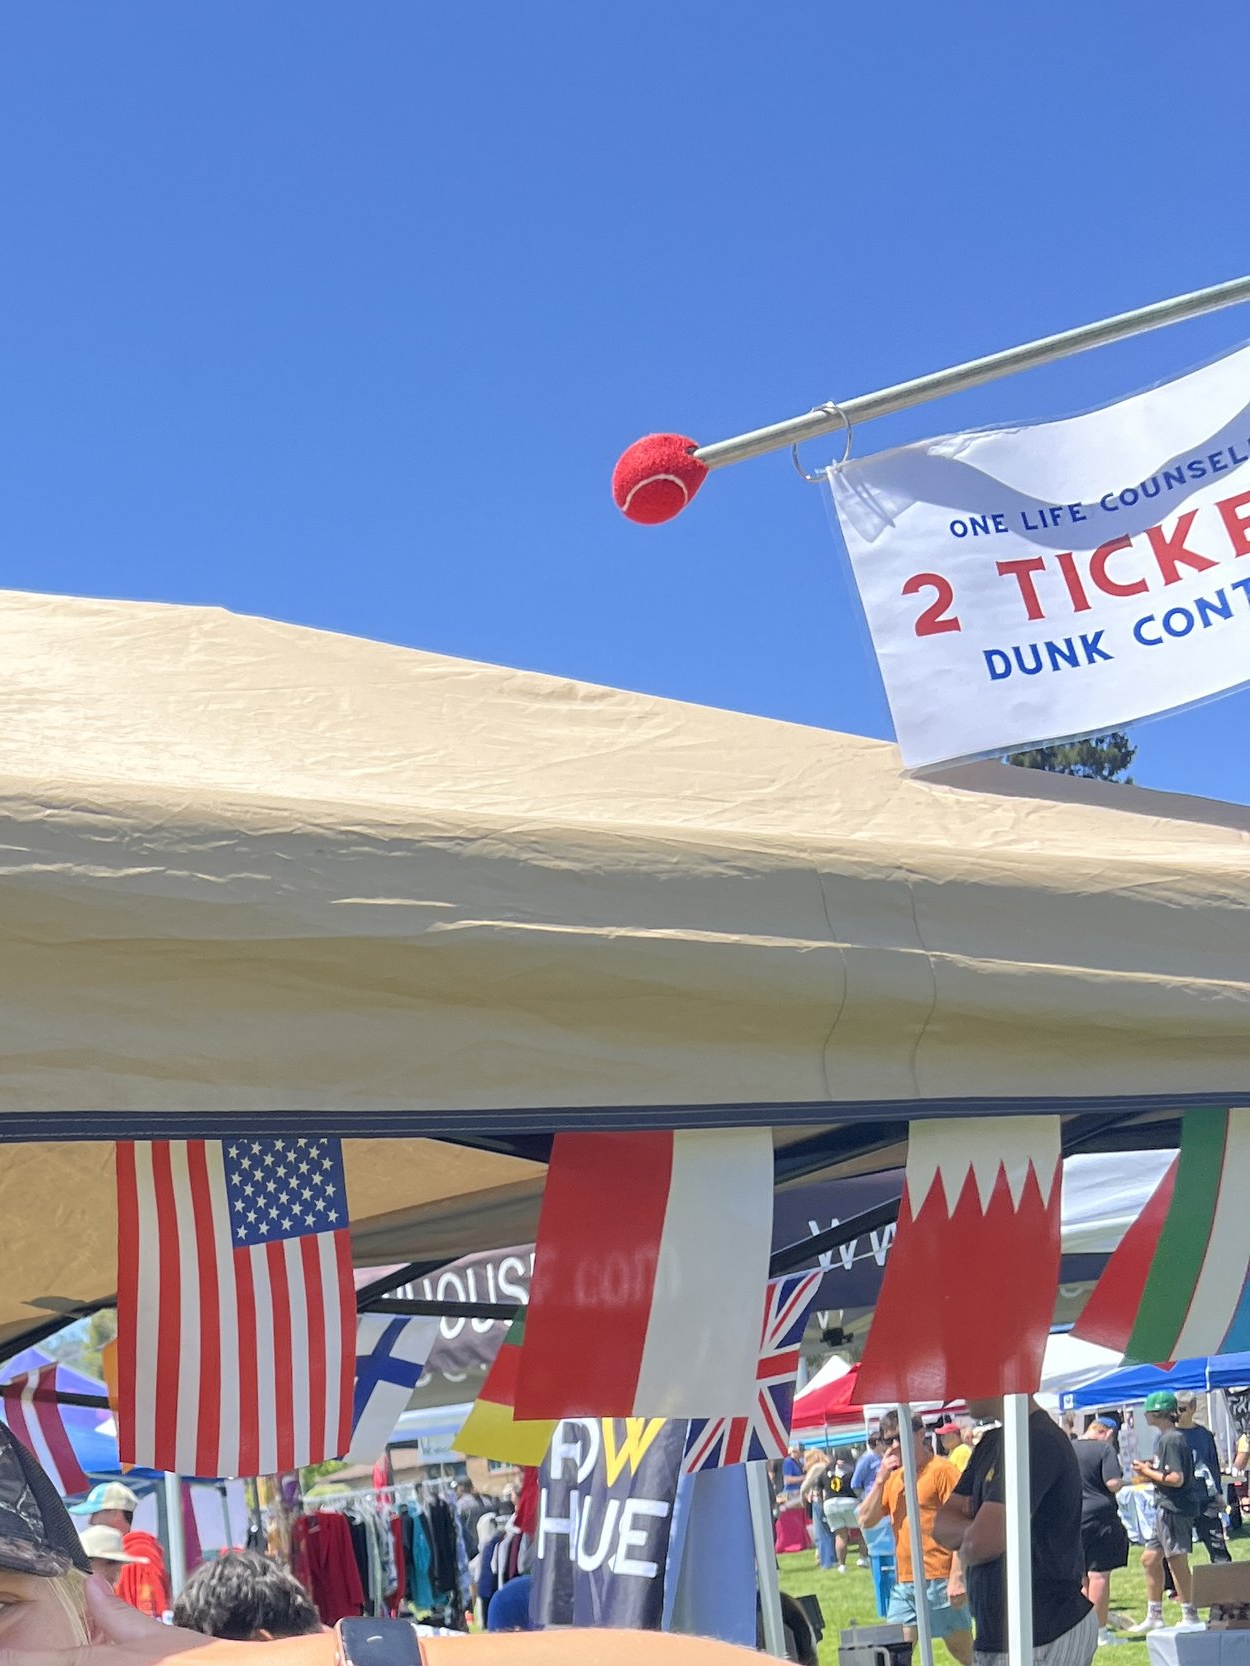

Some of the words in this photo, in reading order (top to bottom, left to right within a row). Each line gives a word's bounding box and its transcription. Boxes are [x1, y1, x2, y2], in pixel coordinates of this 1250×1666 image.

[949, 513, 1009, 538] ONE
[1020, 501, 1088, 531] LIFE
[1099, 438, 1250, 513] COUNSEL
[901, 572, 962, 637] 2
[982, 629, 1115, 681] DUNK
